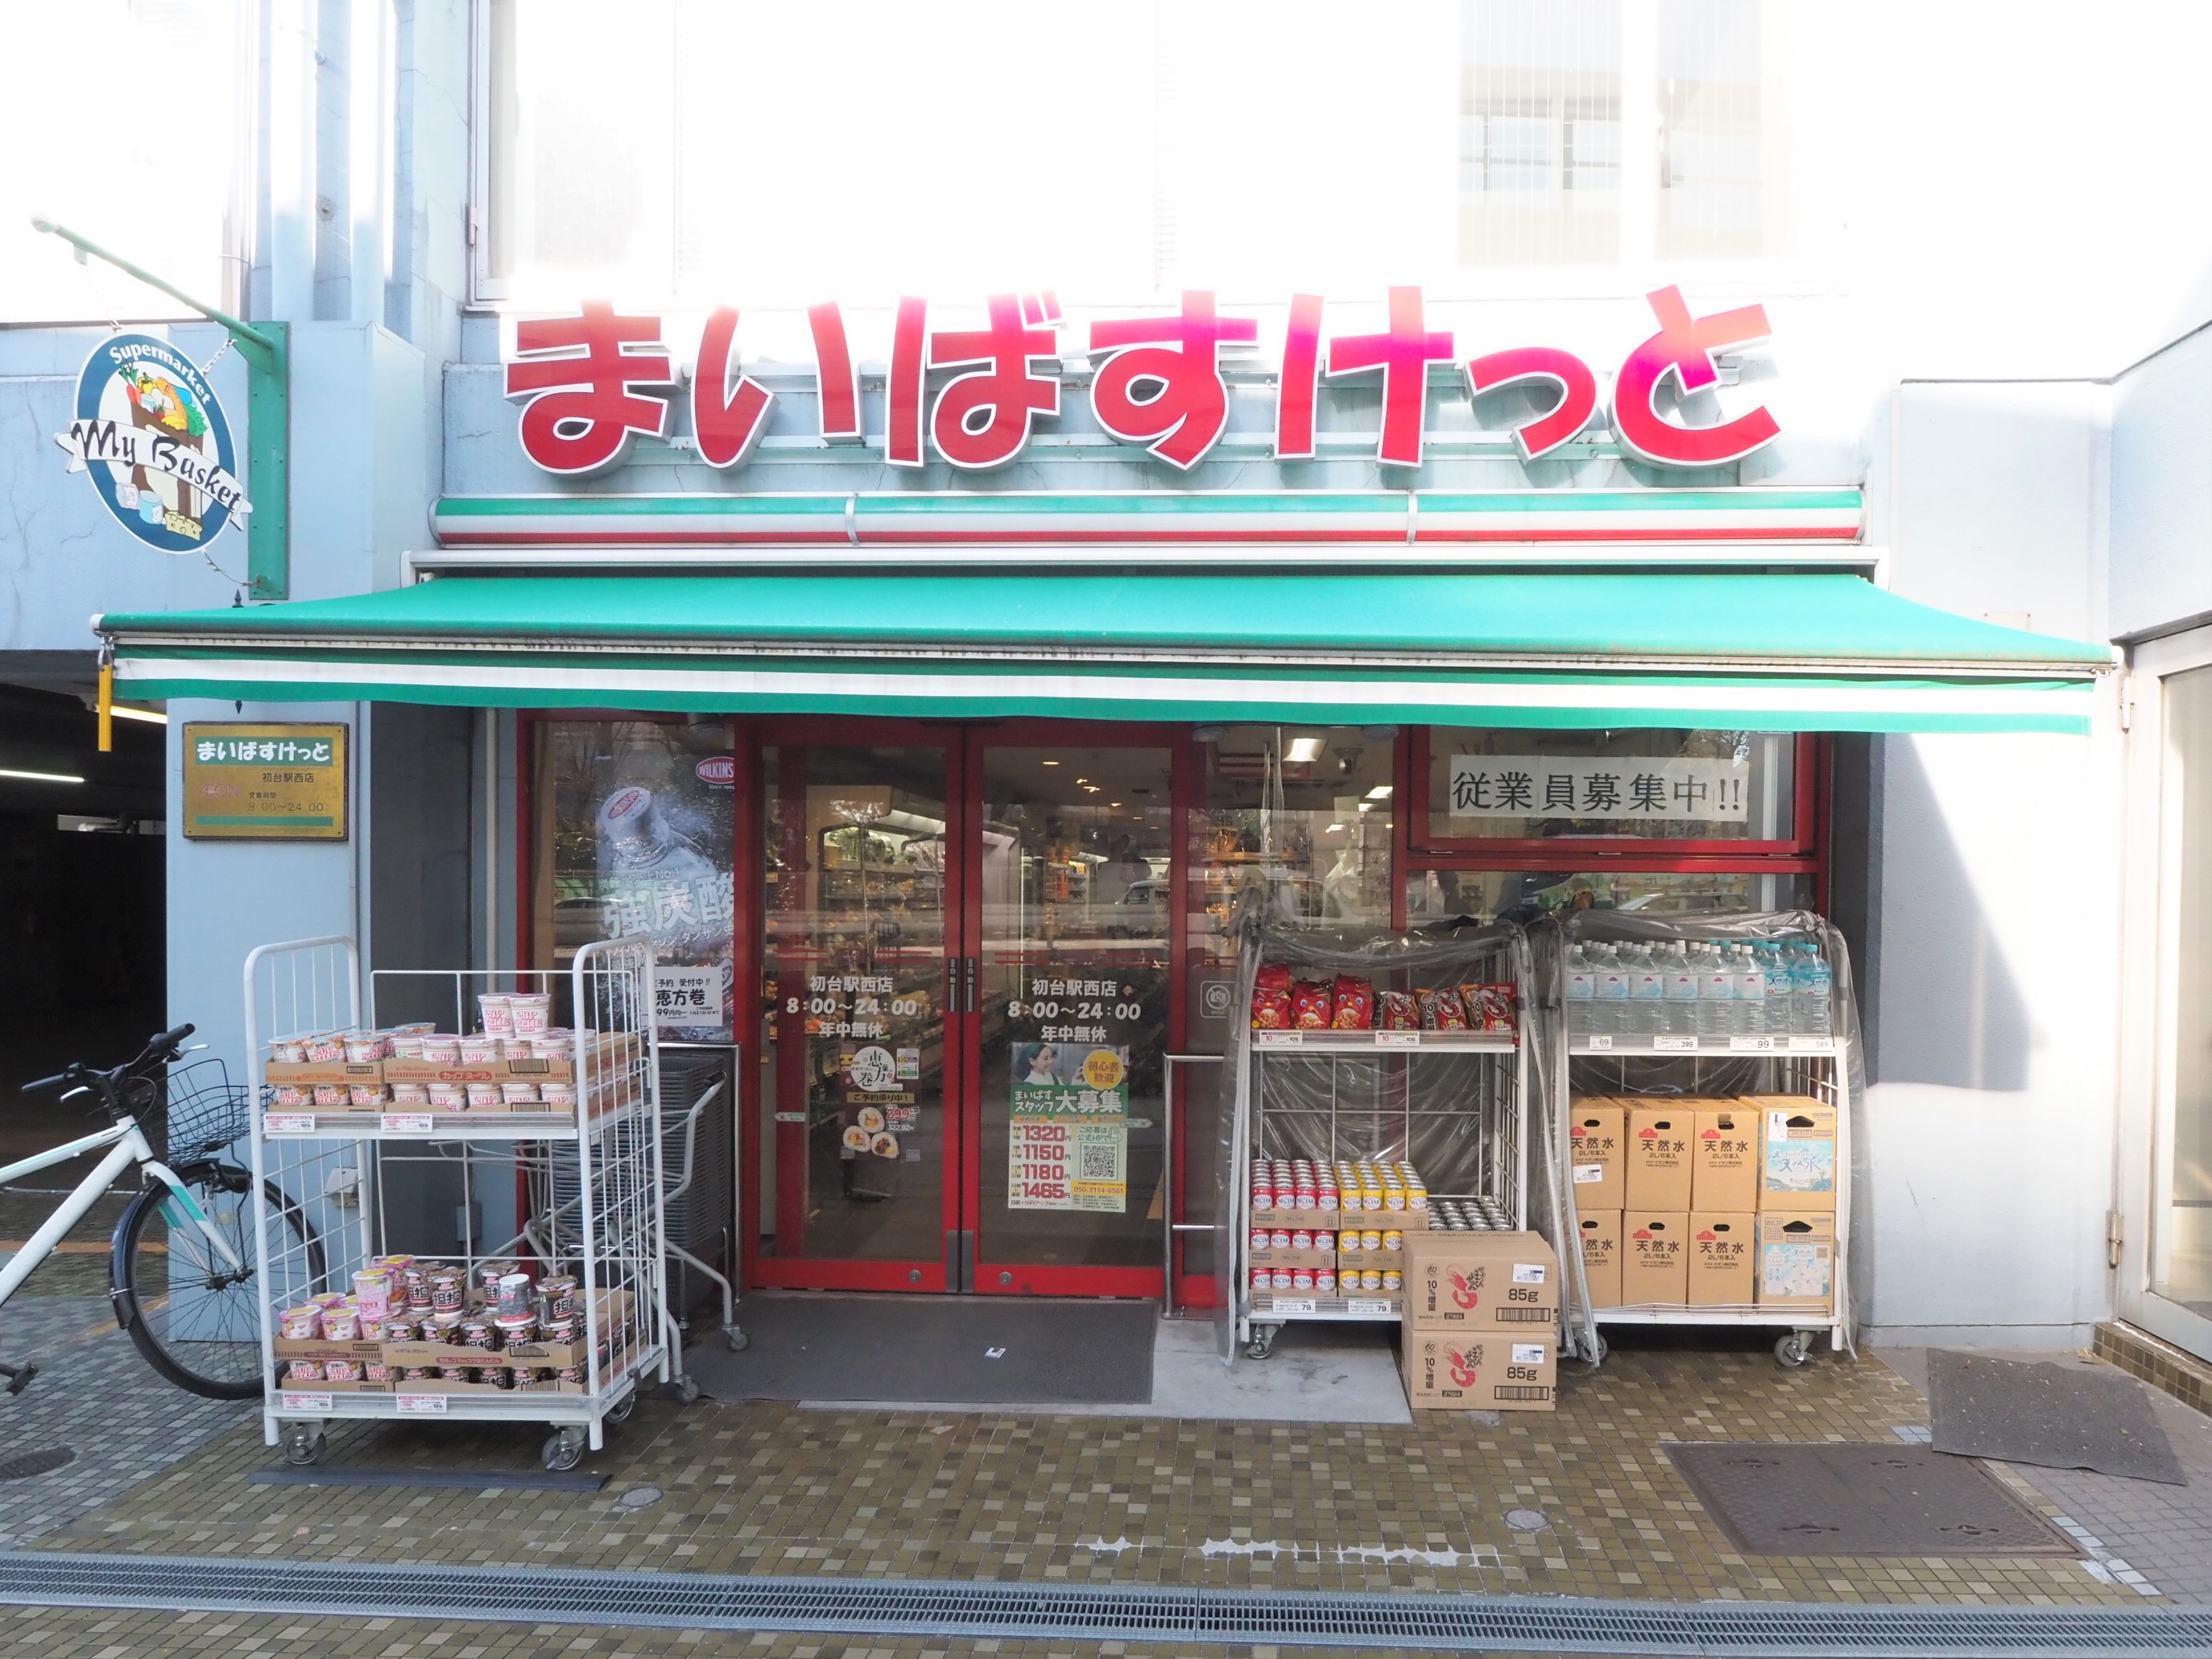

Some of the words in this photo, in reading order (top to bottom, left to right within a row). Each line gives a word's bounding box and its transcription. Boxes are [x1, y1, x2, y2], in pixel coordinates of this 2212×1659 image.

[110, 344, 209, 404] Supermarket
[505, 285, 1781, 475] まいばすけっと
[71, 420, 135, 466] My
[152, 436, 242, 512] Basket
[197, 741, 329, 761] まいばすけっと
[263, 772, 314, 784] 初台駅西店
[1451, 771, 1740, 813] 従業員募集中!!
[810, 976, 894, 993] 初台駅西店
[1032, 979, 1117, 997] 初台駅西店
[655, 989, 705, 1006] 恵方巻
[819, 1022, 884, 1038] 年中無休
[1040, 1025, 1107, 1043] 年中無休
[1757, 1040, 1770, 1049] 99
[1088, 1061, 1119, 1072] 初心者
[443, 1072, 490, 1080] カップヌードル
[1015, 1090, 1052, 1101] まいばす
[1055, 1090, 1122, 1114] 大募集
[1015, 1102, 1054, 1113] スタッフ
[1570, 1137, 1615, 1148] 天然水
[1642, 1140, 1685, 1152] 天然水
[1705, 1140, 1748, 1152] 天然水
[1636, 1240, 1680, 1252] 天然水
[1700, 1242, 1744, 1254] 天然水
[1508, 1289, 1539, 1303] 85g
[1507, 1367, 1537, 1380] 85g
